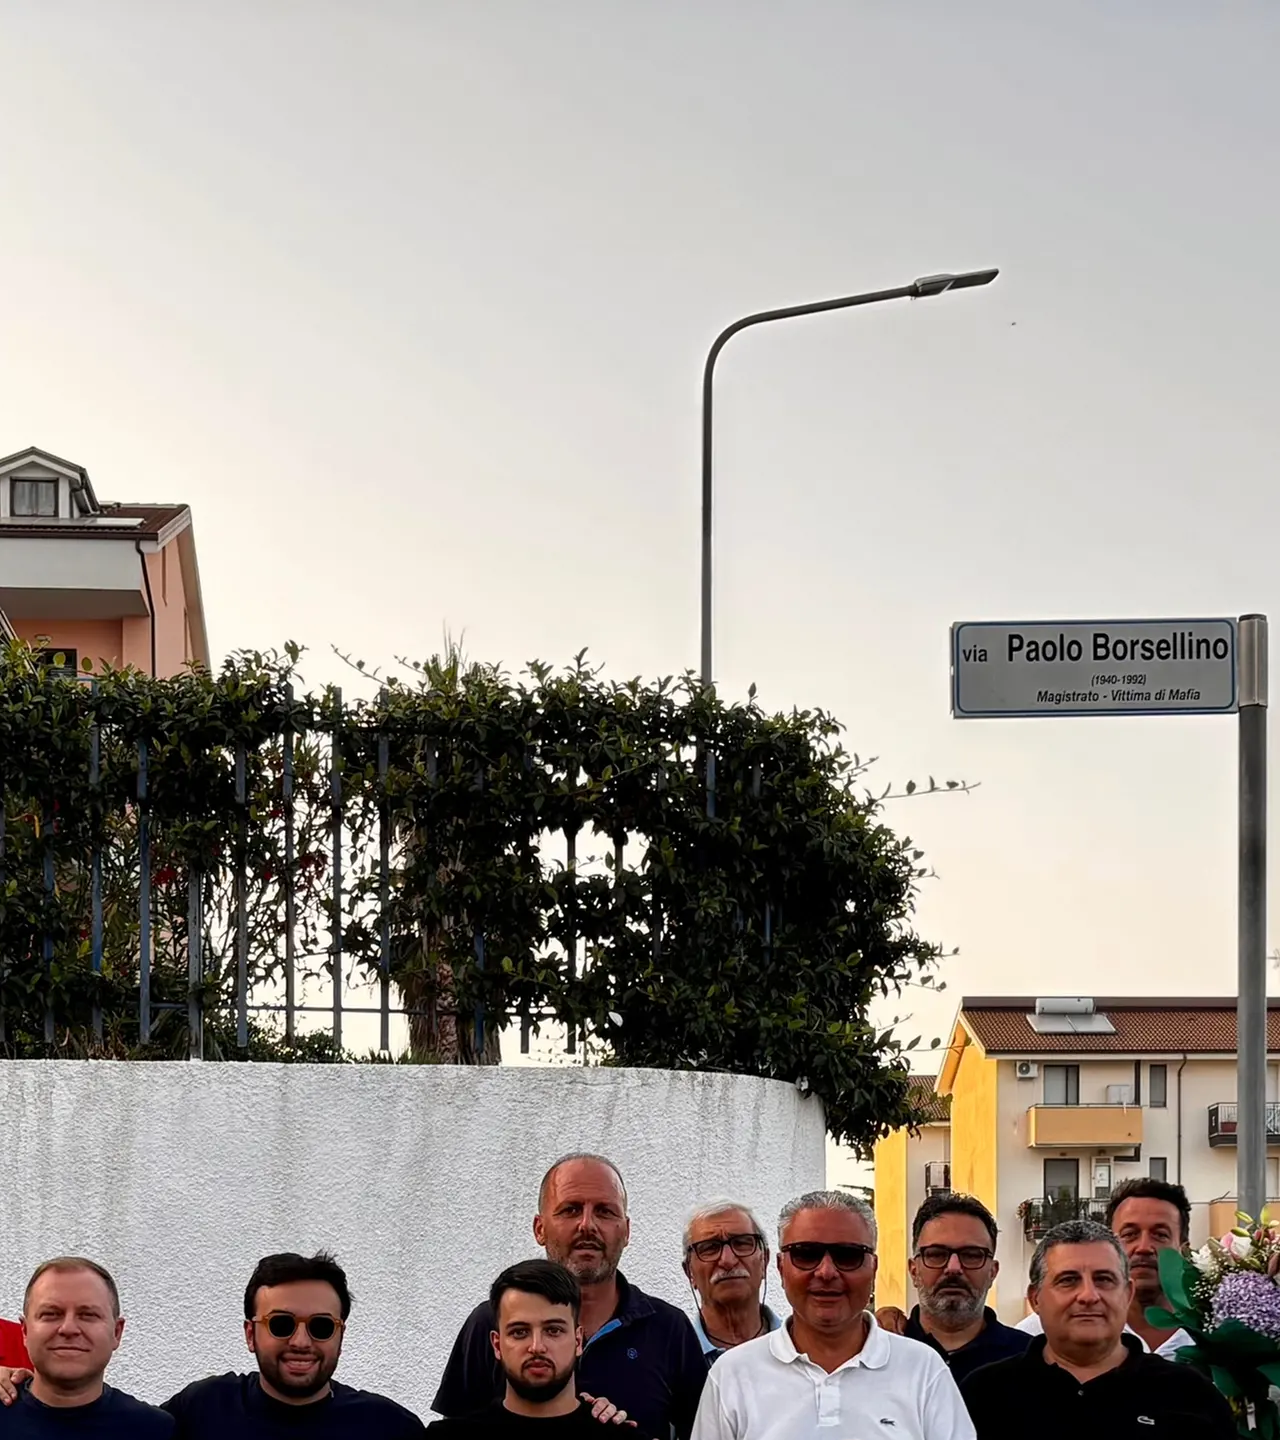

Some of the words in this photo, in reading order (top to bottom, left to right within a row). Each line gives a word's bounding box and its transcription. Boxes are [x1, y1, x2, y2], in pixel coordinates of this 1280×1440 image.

[963, 645, 988, 662] via
[1007, 633, 1083, 662] Paolo
[1092, 631, 1229, 661] Borsellino
[1091, 673, 1147, 687] (1940-1992)
[1036, 690, 1099, 705] Magistrato
[1111, 689, 1151, 701] Vittima
[1154, 688, 1166, 701] di
[1168, 688, 1201, 701] Mafia
